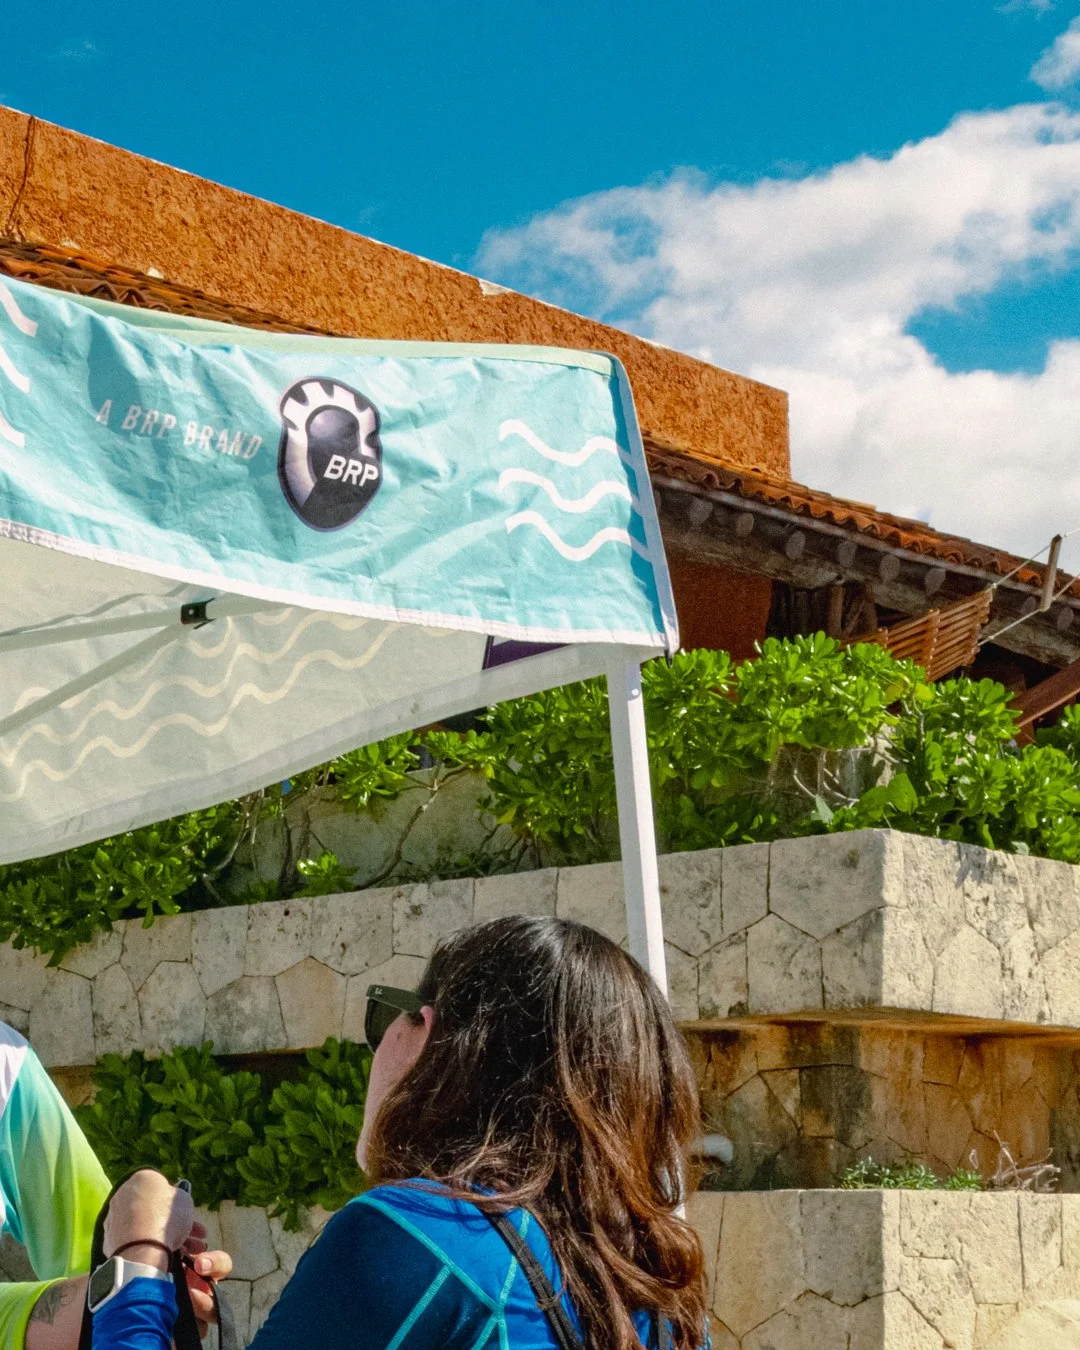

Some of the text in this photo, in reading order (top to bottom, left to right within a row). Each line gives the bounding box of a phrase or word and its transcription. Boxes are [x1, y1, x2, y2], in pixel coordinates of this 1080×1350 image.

[121, 405, 177, 438] BRP
[183, 419, 264, 460] BRAND
[323, 454, 379, 487] BRP
